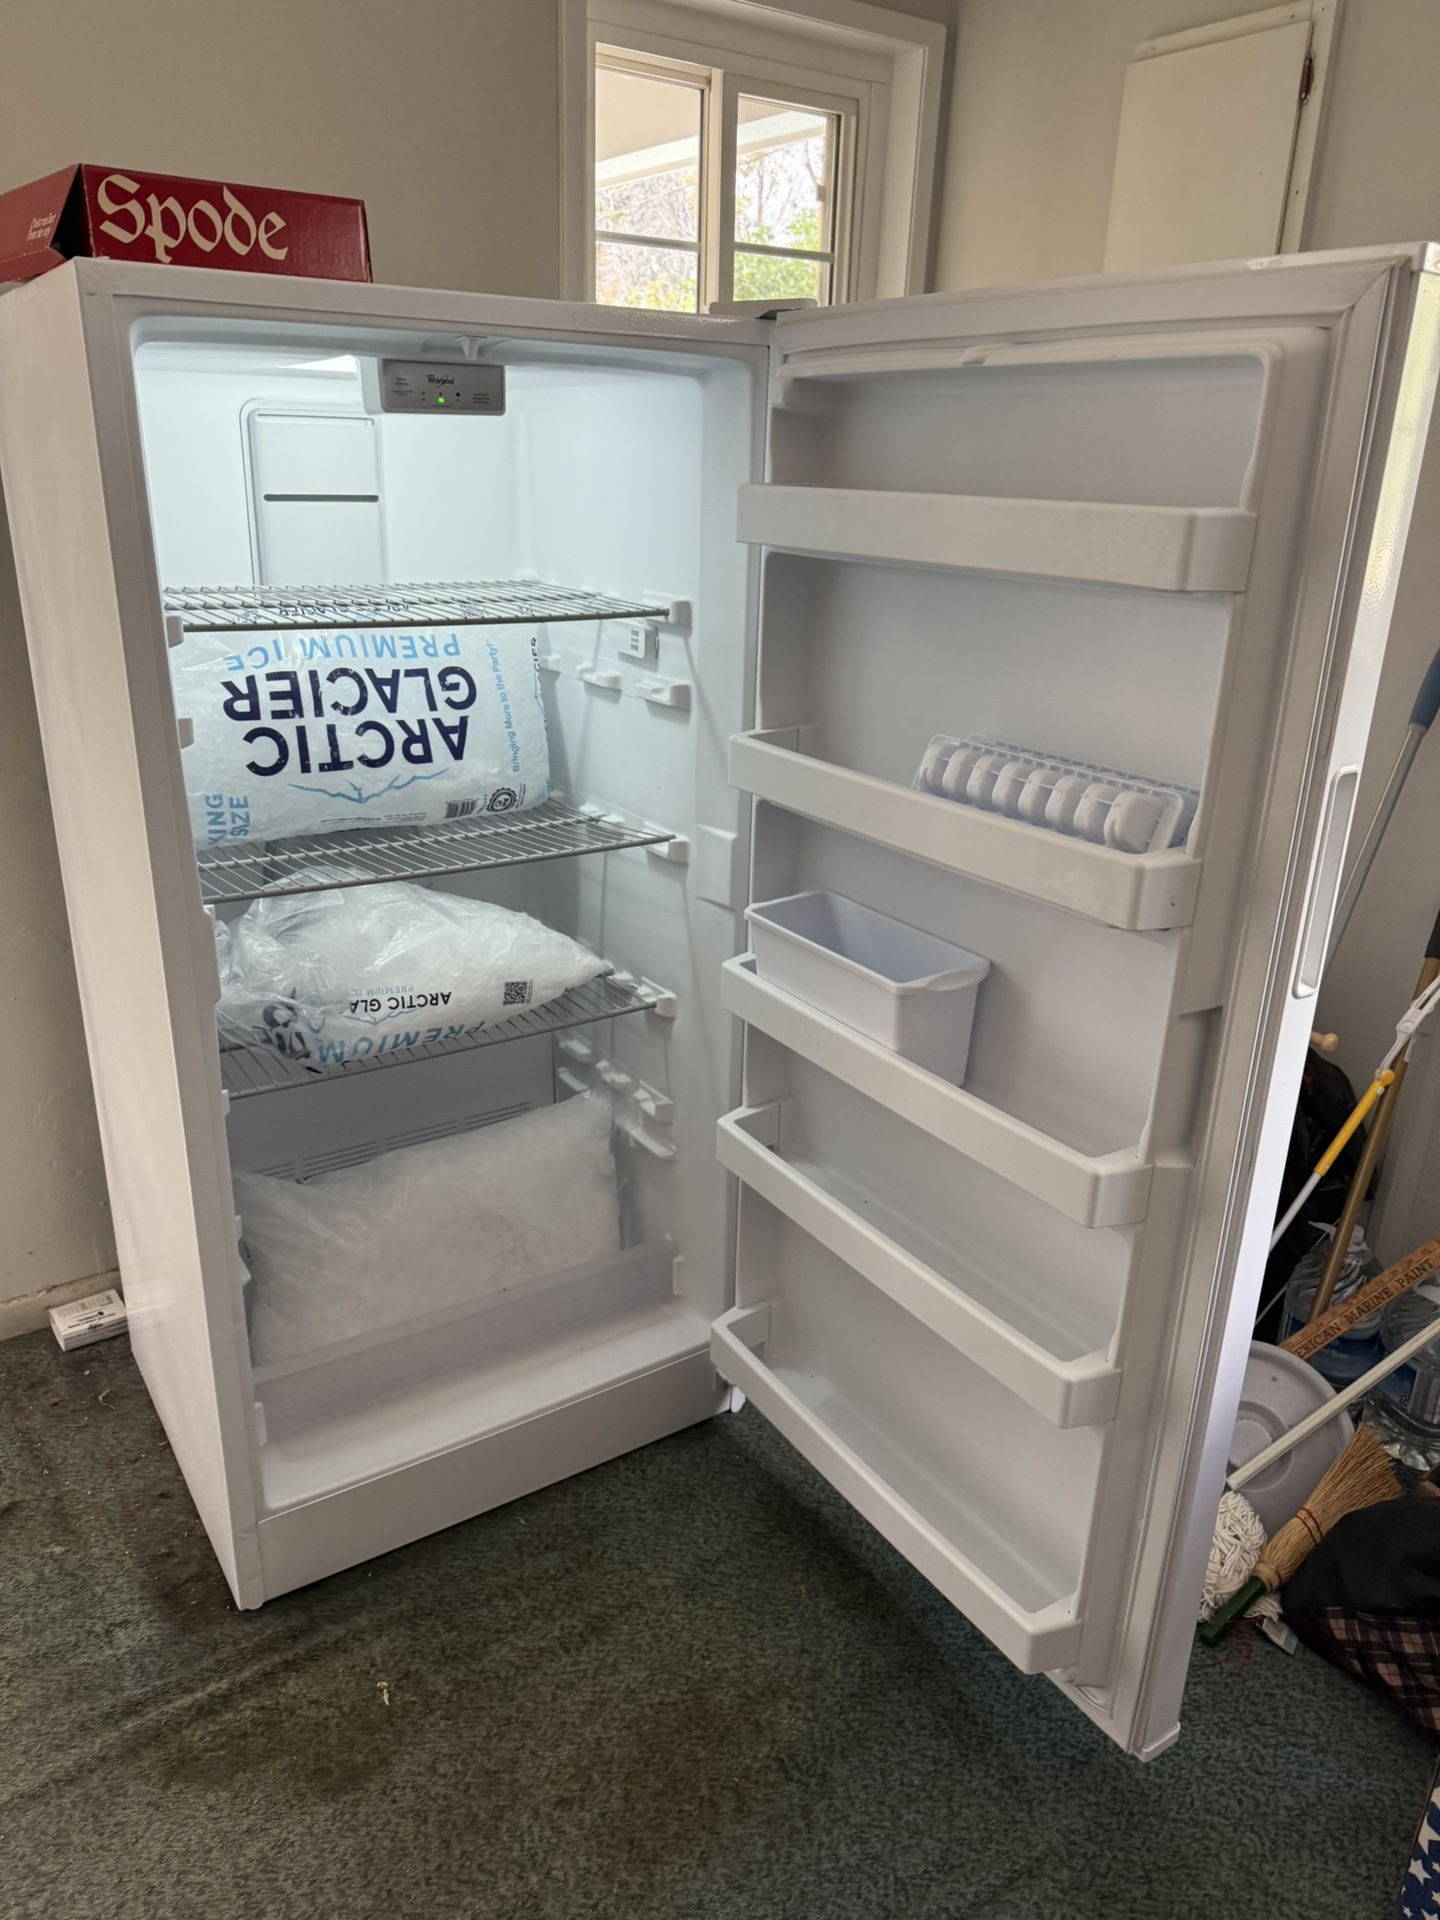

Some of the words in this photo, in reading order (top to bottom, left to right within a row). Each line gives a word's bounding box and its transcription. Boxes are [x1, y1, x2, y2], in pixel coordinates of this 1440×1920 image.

[97, 174, 289, 264] Spode
[223, 638, 283, 672] ICE
[299, 633, 461, 660] PREMIUM
[220, 666, 477, 722] GLACIER
[495, 674, 506, 691] the
[499, 691, 509, 703] to
[503, 704, 514, 729] More
[242, 716, 469, 777] ARCTIC
[507, 730, 520, 773] Bringing
[228, 795, 251, 837] SIZE
[348, 988, 364, 997] IC
[348, 994, 382, 1014] GLA
[366, 985, 415, 996] PREMIUM
[387, 991, 452, 1011] ARCTIC
[317, 1021, 484, 1064] PREMIUM
[1293, 1321, 1343, 1358] ERICAN
[1343, 1286, 1394, 1325] MARINE
[1395, 1257, 1436, 1290] PAINT
